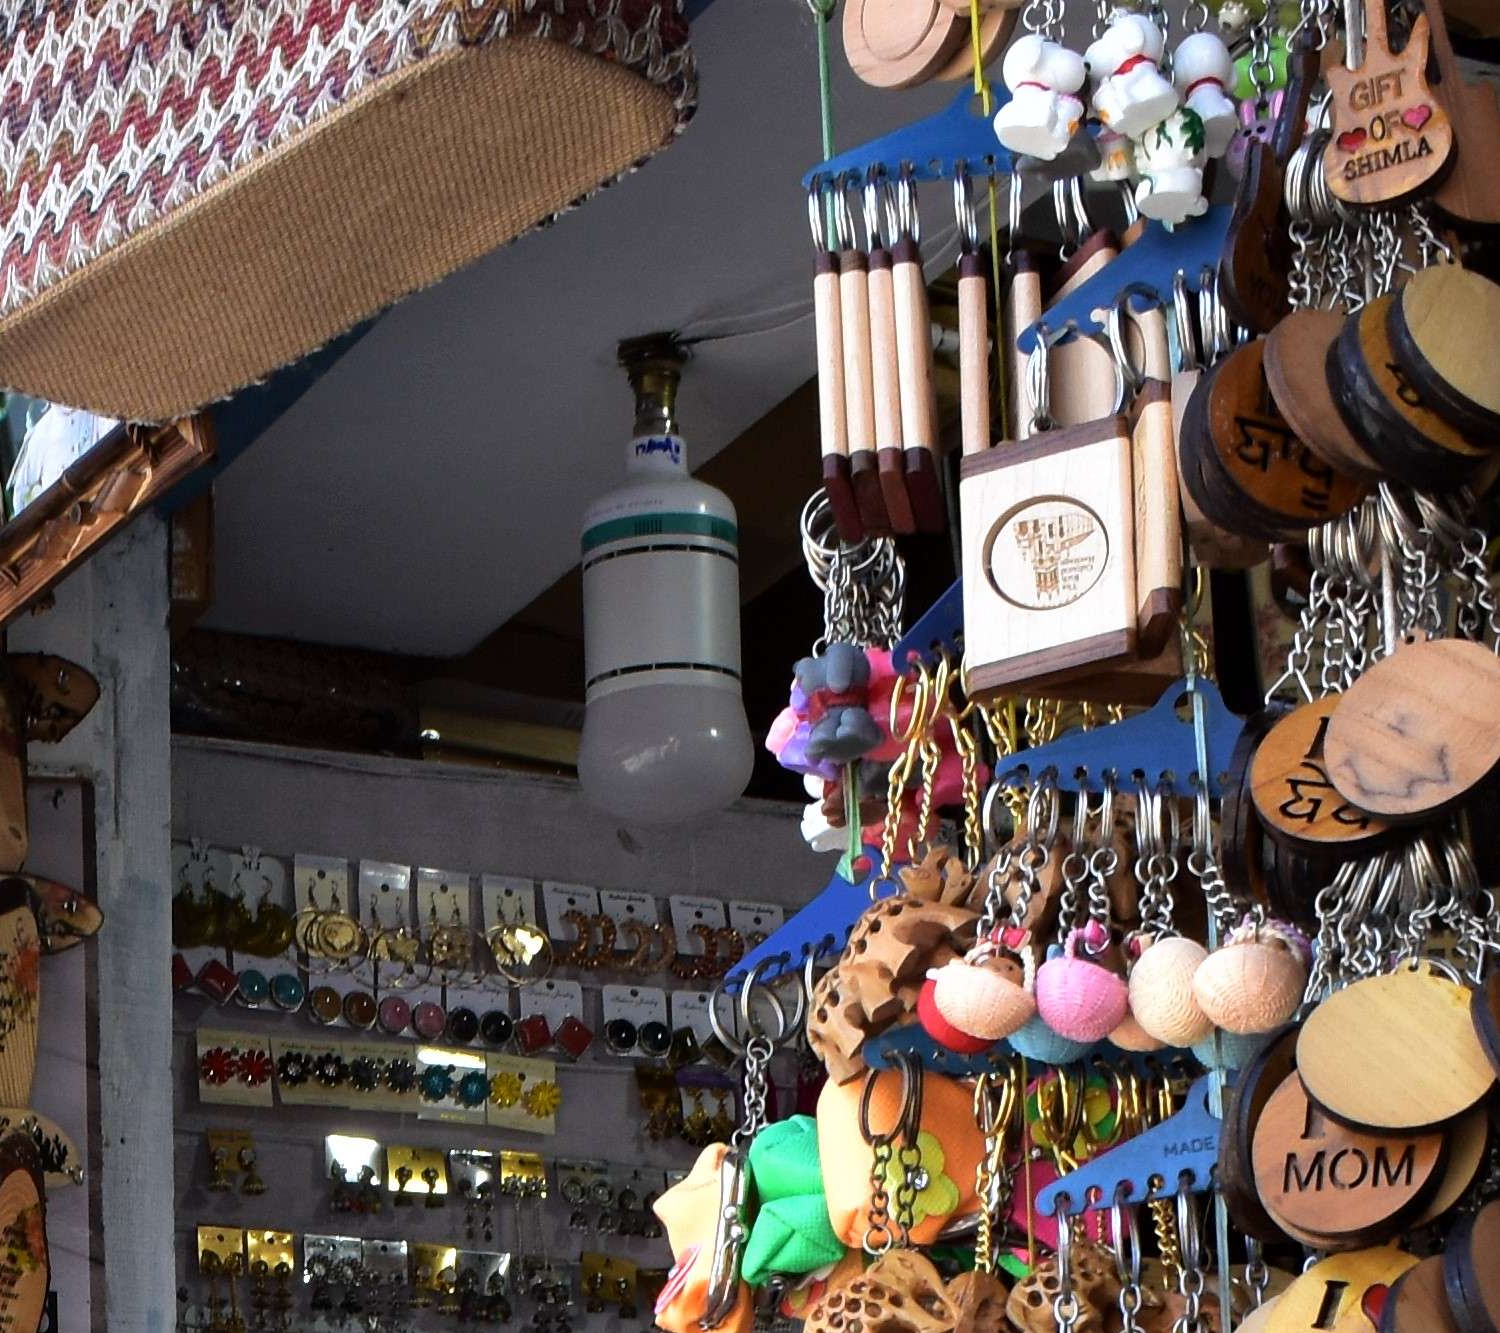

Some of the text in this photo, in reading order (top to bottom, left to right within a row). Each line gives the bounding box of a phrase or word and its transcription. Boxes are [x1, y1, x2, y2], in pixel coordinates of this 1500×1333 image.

[1350, 68, 1407, 111] GIFT
[1369, 111, 1402, 141] OF
[1343, 138, 1433, 181] SHIMLA
[1282, 1144, 1418, 1193] MOM
[1311, 1279, 1350, 1328] I
